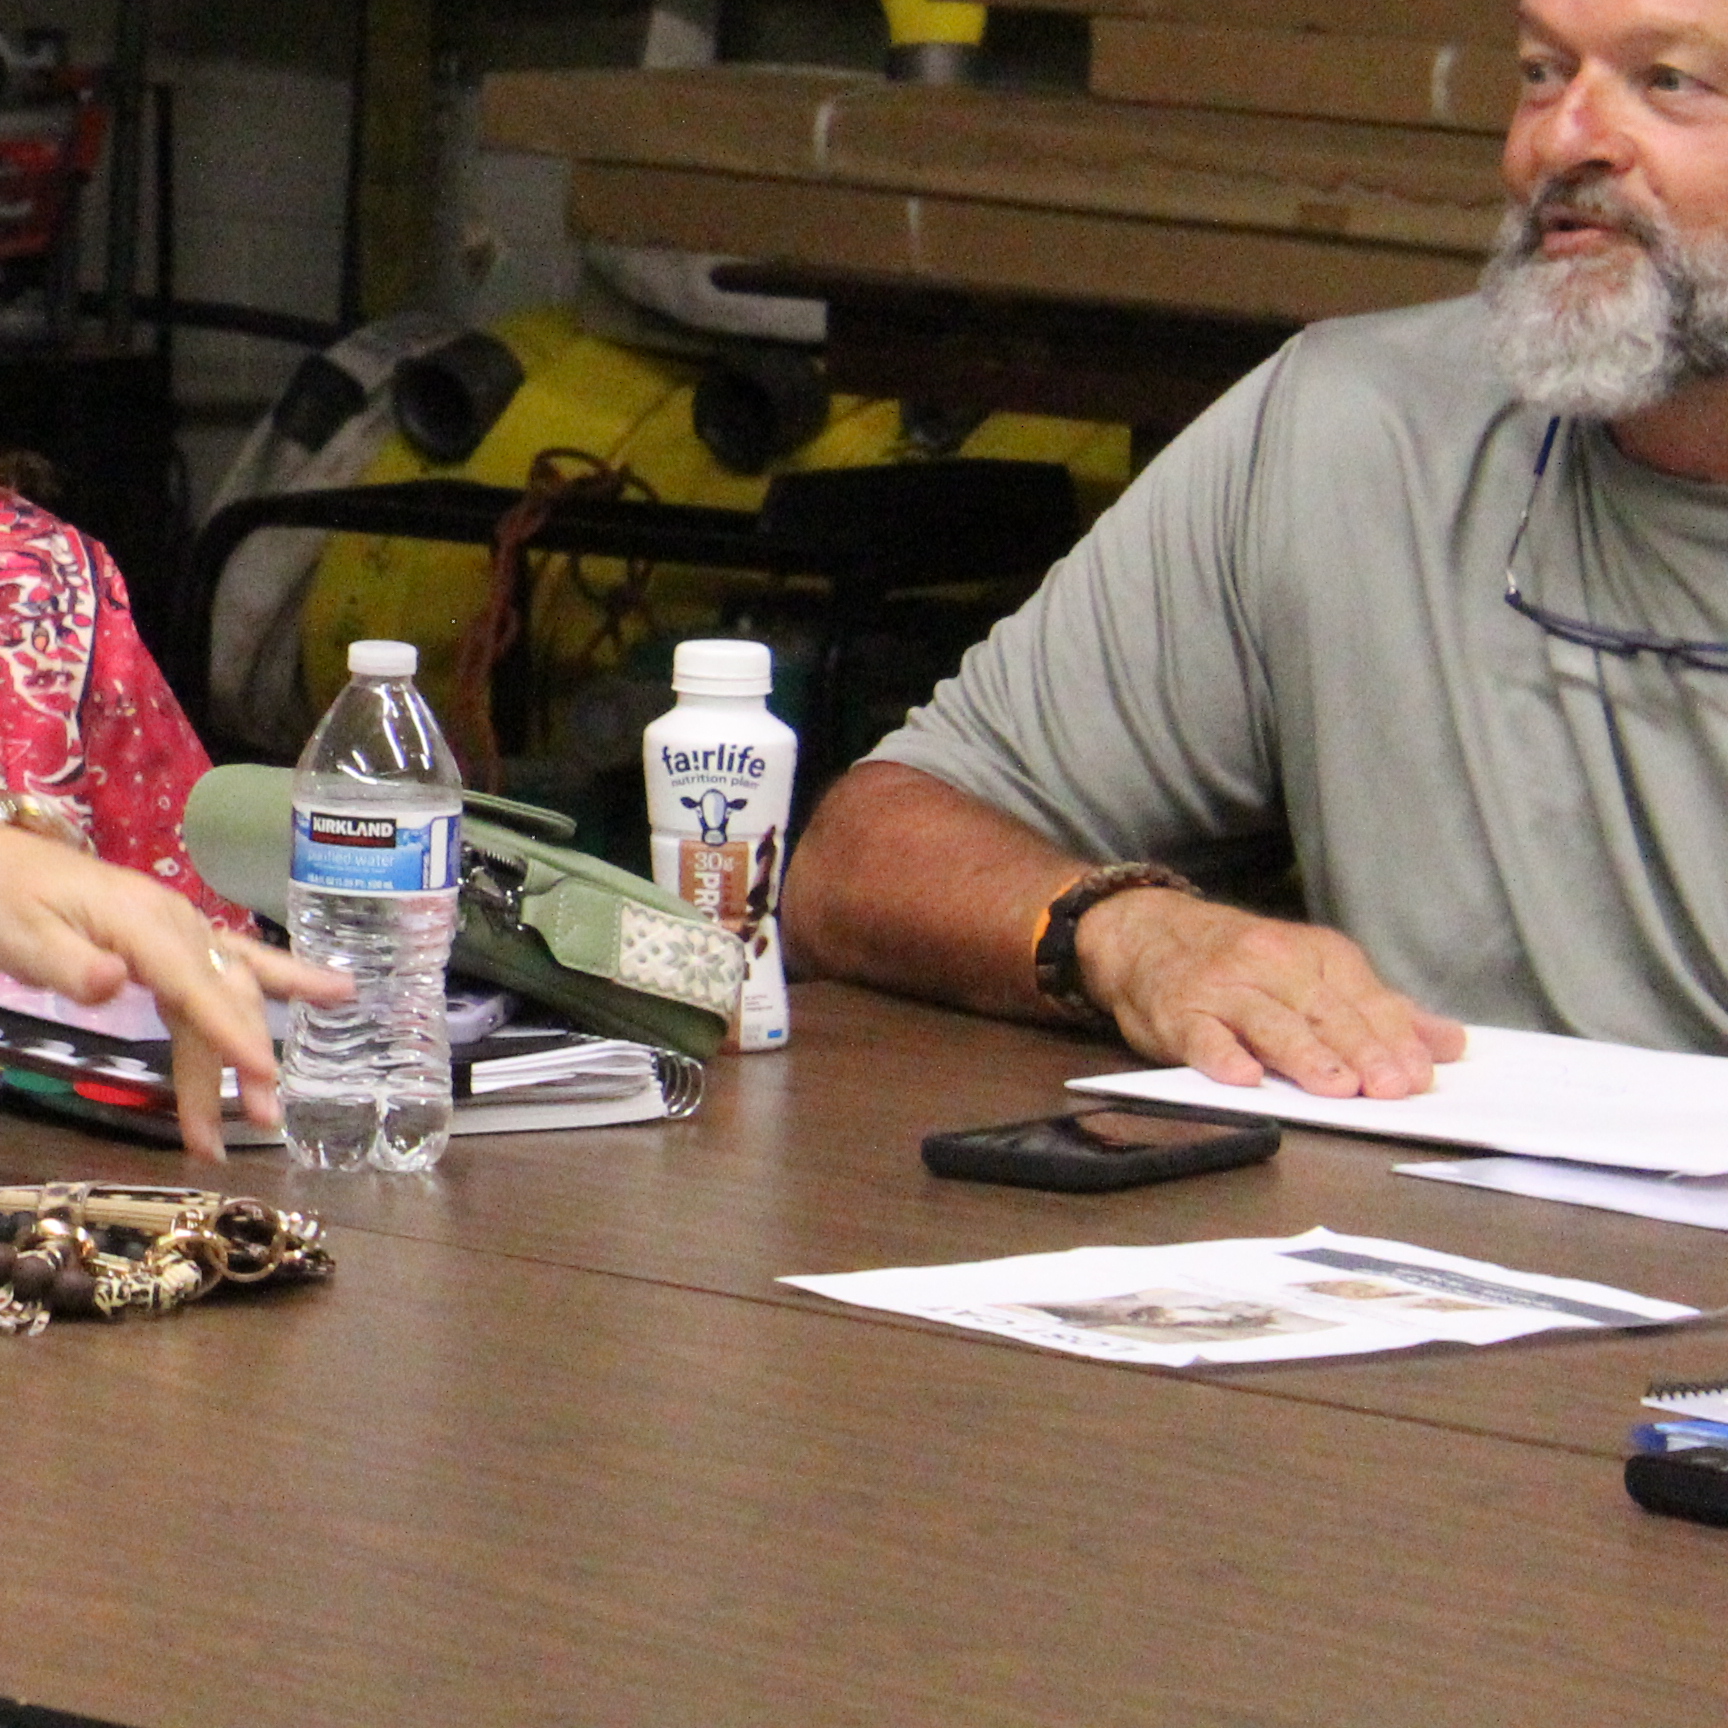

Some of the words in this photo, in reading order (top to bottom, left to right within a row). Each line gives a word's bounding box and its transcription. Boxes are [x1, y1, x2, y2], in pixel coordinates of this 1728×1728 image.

[670, 773, 727, 787] nutrition
[730, 776, 760, 789] plan
[312, 816, 394, 838] KIRKLAND
[354, 854, 396, 868] water
